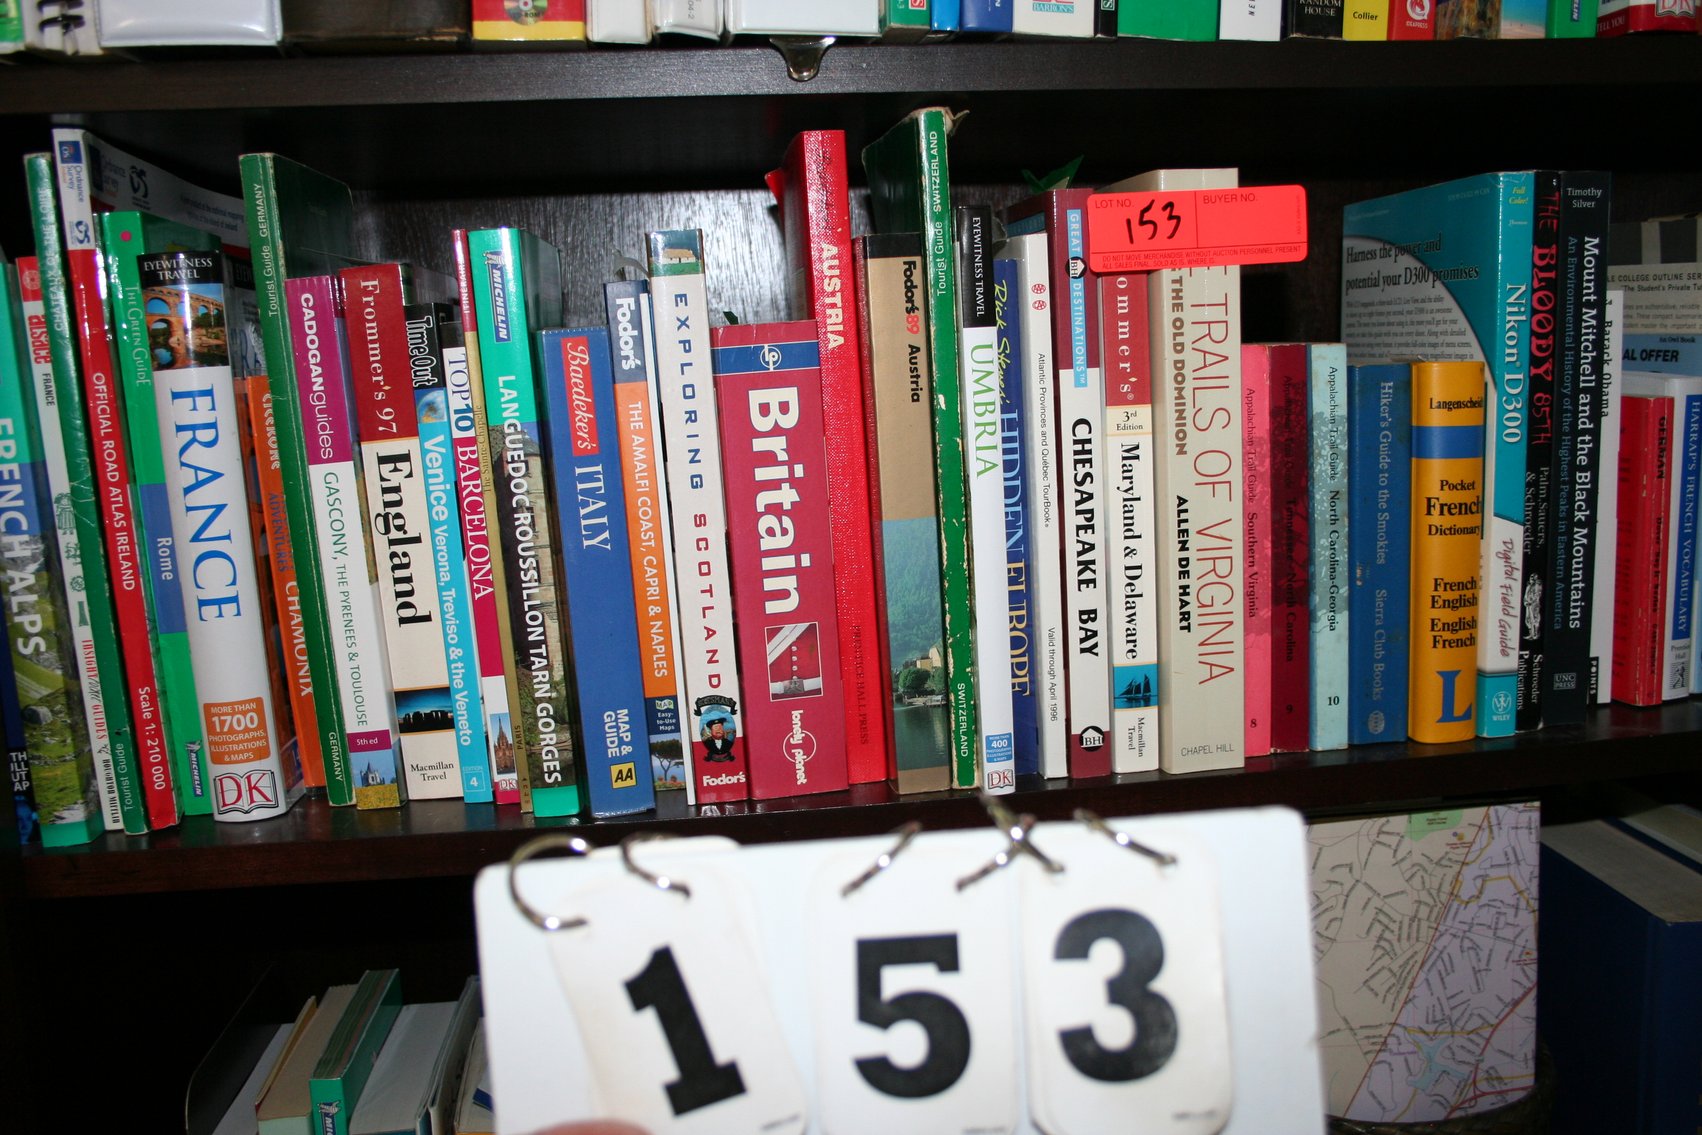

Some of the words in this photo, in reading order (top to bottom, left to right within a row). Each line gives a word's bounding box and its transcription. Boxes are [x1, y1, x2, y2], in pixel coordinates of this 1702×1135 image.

[1032, 3, 1074, 13] BARRON'S
[1304, 6, 1336, 16] HOUSE
[1352, 11, 1378, 21] Collier
[929, 131, 943, 214] SWITZERLAND
[1567, 188, 1602, 198] Timothy
[254, 183, 268, 238] GERMANY
[1095, 199, 1114, 209] LOT
[1117, 198, 1134, 208] NO.
[1203, 194, 1238, 204] BUYER
[1240, 193, 1257, 203] NO.
[1572, 200, 1595, 208] Silver
[935, 221, 945, 254] Guide
[1069, 213, 1081, 252] GREAT
[1126, 199, 1182, 245] 153
[143, 257, 213, 271] EYEWITNESS
[263, 245, 275, 277] Guide
[972, 217, 983, 279] EYEWITNESS
[1143, 251, 1183, 260] MERCHANDISE
[1185, 249, 1211, 258] WITHOUT
[1213, 248, 1238, 256] AUCTION
[1240, 246, 1273, 255] PERSONNEL
[1276, 245, 1301, 253] PRESENT
[1346, 246, 1377, 263] Harness
[1583, 236, 1600, 303] Mount
[158, 268, 200, 281] TRAVEL
[821, 243, 845, 350] AUSTRIA
[937, 257, 949, 296] Tourist
[1172, 275, 1183, 312] THE
[1346, 270, 1380, 295] potential
[1404, 266, 1429, 285] D300
[1432, 262, 1479, 288] promises
[1618, 273, 1649, 282] COLLEGE
[1652, 272, 1684, 281] OUTLINE
[1637, 284, 1666, 292] Student's
[1667, 283, 1690, 291] Private
[47, 271, 65, 331] CHATEAUX
[266, 281, 278, 317] Tourist
[493, 269, 508, 339] MICHELIN
[974, 280, 985, 317] TRAVEL
[1530, 244, 1559, 382] BLOODY
[1565, 257, 1578, 348] Environmental
[615, 297, 642, 371] Fodor's
[1172, 317, 1185, 354] OLD
[1579, 308, 1597, 388] Mitchell
[1640, 348, 1679, 362] OFFER
[908, 343, 923, 403] Austria
[1190, 292, 1231, 432] TRAILS
[42, 373, 56, 406] FRANCE
[93, 372, 111, 436] OFFICIAL
[566, 343, 597, 450] Baedeker's
[970, 342, 999, 480] UMBRIA
[1172, 359, 1187, 456] DOMINION
[1328, 366, 1338, 424] Appalachian
[1380, 382, 1393, 428] Hiker's
[1502, 372, 1524, 443] D300
[1578, 394, 1595, 430] and
[1601, 373, 1612, 417] Obama
[376, 407, 397, 434] 97
[628, 400, 643, 430] THE
[1117, 423, 1143, 432] Edition
[1688, 401, 1701, 471] HARRAP'S
[102, 440, 120, 482] ROAD
[474, 405, 490, 474] Sainte-Chapelle
[498, 375, 531, 508] LANGUEDOC
[1379, 431, 1392, 470] Guide
[1576, 436, 1593, 466] the
[1657, 416, 1667, 479] GERMAN
[422, 434, 451, 522] Venice
[631, 434, 650, 493] AMALFI
[1193, 449, 1232, 502] OF
[1440, 480, 1475, 491] Pocket
[110, 487, 127, 528] ATLAS
[170, 384, 242, 622] FRANCE
[575, 464, 611, 551] ITALY
[674, 293, 704, 490] EXPLORING
[693, 513, 722, 689] SCOTLAND
[748, 386, 812, 615] Britain
[1072, 418, 1097, 592] CHESAPEAKE
[1117, 442, 1142, 540] Maryland
[1329, 490, 1340, 526] North
[1574, 471, 1591, 522] Black
[323, 472, 348, 560] GASCONY,
[374, 449, 433, 628] England
[457, 444, 495, 600] BARCELONA
[638, 496, 656, 552] COAST,
[1176, 495, 1189, 552] ALLEN
[1428, 525, 1479, 536] Dictionary
[116, 531, 136, 591] IRELAND
[157, 537, 173, 581] Rome
[431, 525, 450, 587] Verona,
[1247, 512, 1258, 568] Southern
[1376, 514, 1390, 565] Smokies
[336, 564, 349, 587] THE
[514, 512, 545, 641] ROUSSILLON
[642, 555, 661, 601] CAPRI
[1177, 557, 1190, 580] DE
[1433, 577, 1477, 592] French
[1569, 528, 1588, 629] Mountains
[1678, 539, 1692, 632] VOCABULARY
[7, 571, 46, 656] ALPS
[442, 588, 463, 645] Treviso
[1123, 563, 1144, 660] Delaware
[1177, 584, 1191, 632] HART
[1196, 518, 1234, 685] VIRGINIA
[1247, 572, 1258, 618] Virginia
[1375, 589, 1387, 626] Sierra
[1431, 594, 1478, 611] English
[340, 591, 357, 648] PYRENEES
[1078, 608, 1099, 657] BAY
[1430, 617, 1477, 634] English
[1432, 634, 1476, 649] French
[82, 639, 98, 678] INSIGHT
[649, 620, 668, 678] NAPLES
[1374, 630, 1386, 659] Club
[451, 661, 466, 689] the
[529, 646, 553, 698] TARN
[1517, 650, 1530, 710] Publications
[1531, 654, 1543, 704] Schroeder
[138, 686, 154, 720] Scale
[210, 704, 233, 713] MORE
[234, 702, 256, 711] THAN
[350, 665, 368, 727] TOULOUSE
[454, 691, 473, 747] Veneto
[1436, 670, 1472, 723] L
[91, 704, 107, 740] GUIDES
[212, 712, 259, 732] 1700
[514, 725, 523, 750] PARIS
[604, 711, 620, 758] GUIDE
[617, 709, 631, 737] MAP
[957, 682, 969, 757] SWITZERLAND
[115, 743, 128, 773] Guide
[209, 740, 267, 752] ILLUSTRATIONS
[329, 732, 344, 782] GERMANY
[536, 702, 562, 784] GORGES
[991, 740, 1008, 748] 400
[1181, 746, 1213, 757] CHAPEL
[1216, 743, 1234, 754] HILL
[102, 759, 116, 794] HOUGHTON
[190, 752, 202, 797] MICHELIN
[410, 761, 454, 773] Macmillan
[420, 772, 447, 782] Travel
[702, 772, 746, 787] Fodor's
[120, 777, 133, 811] Tourist
[217, 773, 273, 808] DK
[623, 944, 747, 1119] 1
[855, 933, 972, 1100] 5
[1053, 907, 1178, 1084] 3
